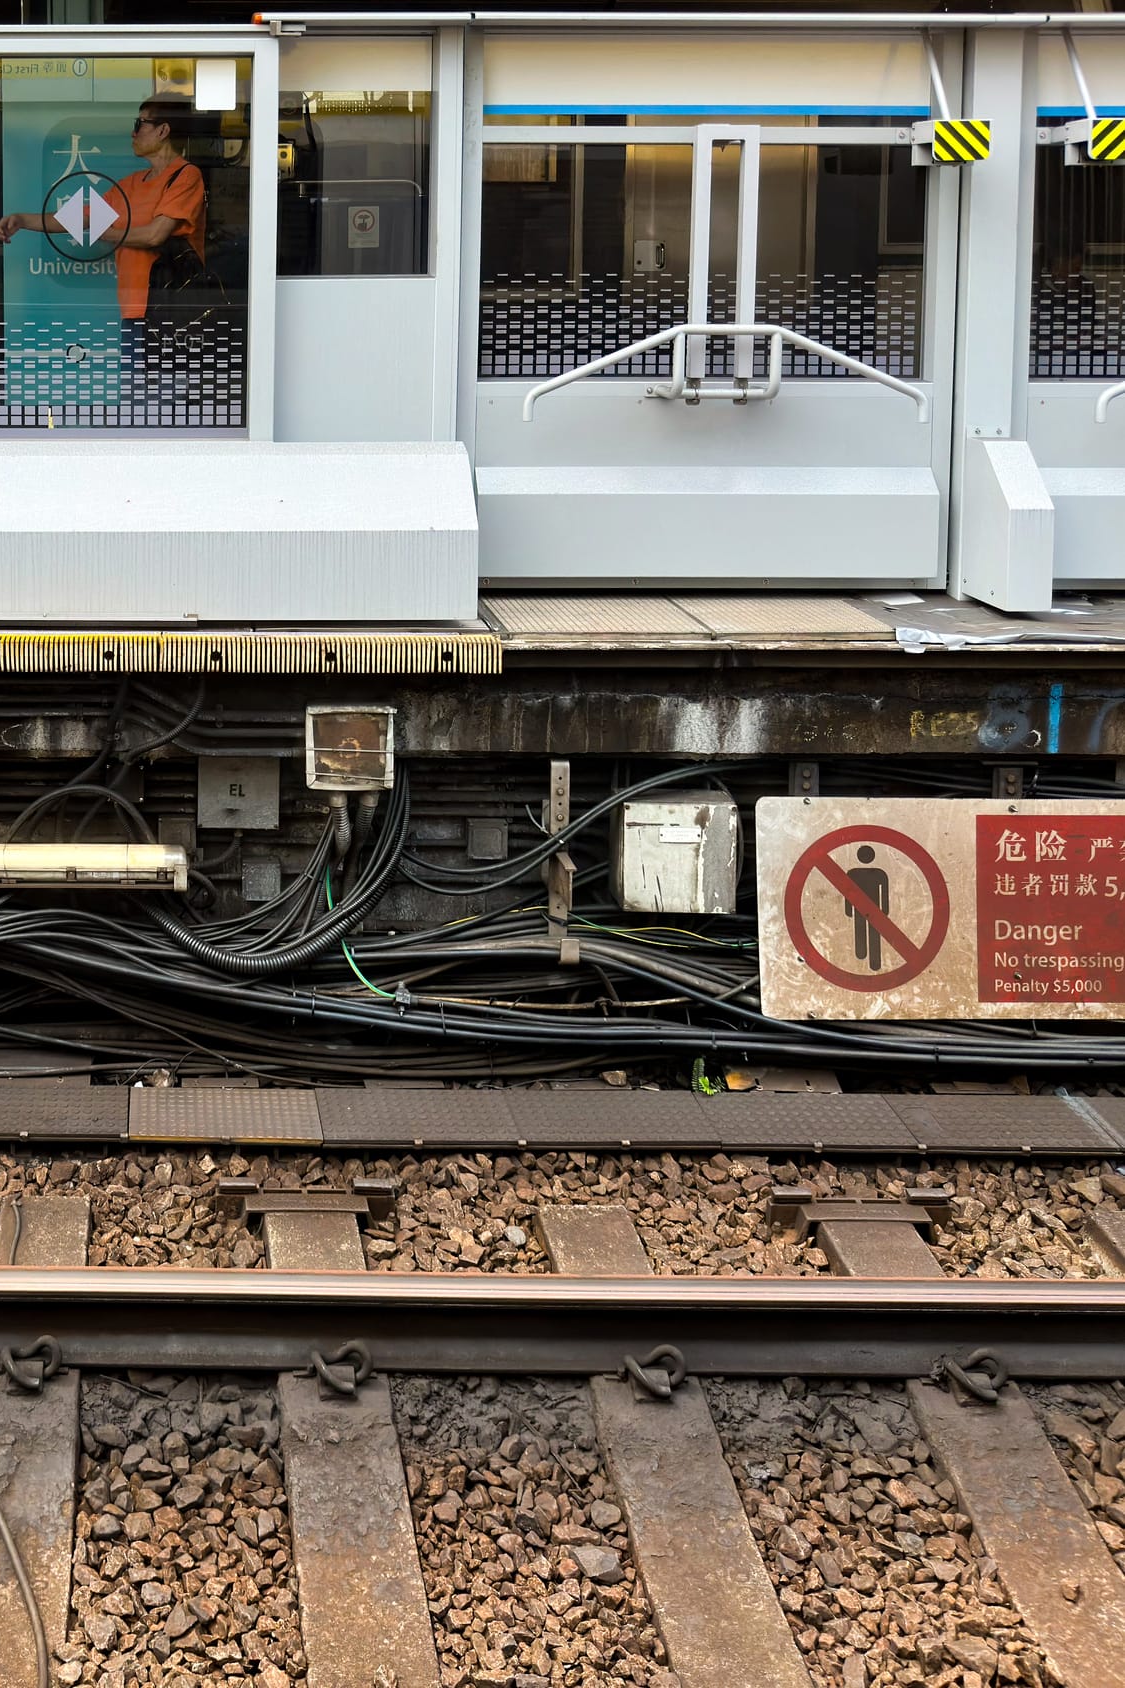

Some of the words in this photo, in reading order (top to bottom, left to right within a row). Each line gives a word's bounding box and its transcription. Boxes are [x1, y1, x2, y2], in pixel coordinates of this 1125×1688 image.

[230, 784, 246, 797] EL
[994, 829, 1067, 863] 危险
[994, 873, 1097, 897] 违者罚款
[994, 919, 1083, 946] Danger
[994, 952, 1019, 968] No
[1023, 952, 1124, 972] trespassing
[994, 979, 1049, 993] Penalty
[1053, 979, 1102, 994] $5,000
